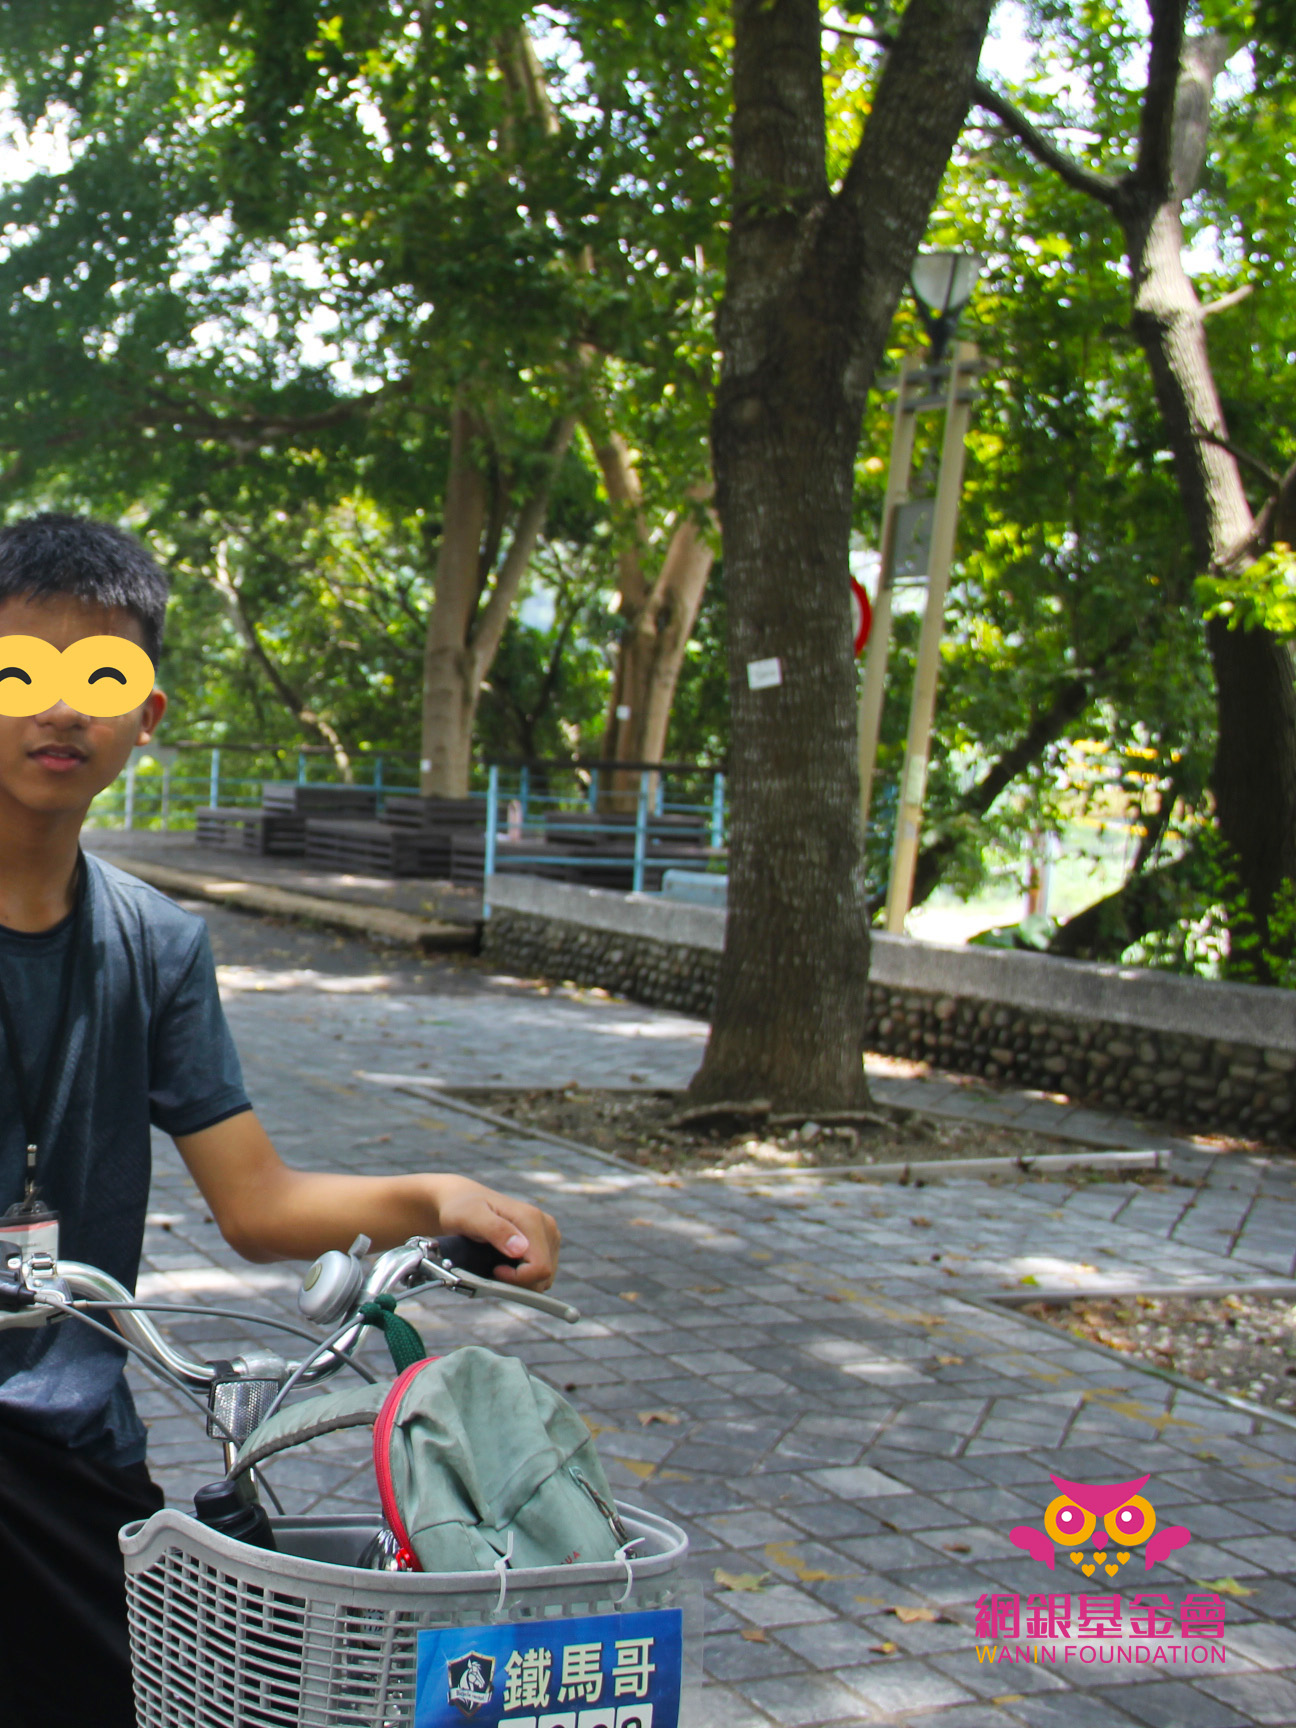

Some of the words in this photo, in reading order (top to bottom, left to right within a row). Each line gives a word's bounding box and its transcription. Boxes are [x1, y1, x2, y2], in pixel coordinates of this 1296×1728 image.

[560, 1550, 581, 1565] UA
[503, 1636, 656, 1712] 鐵馬哥
